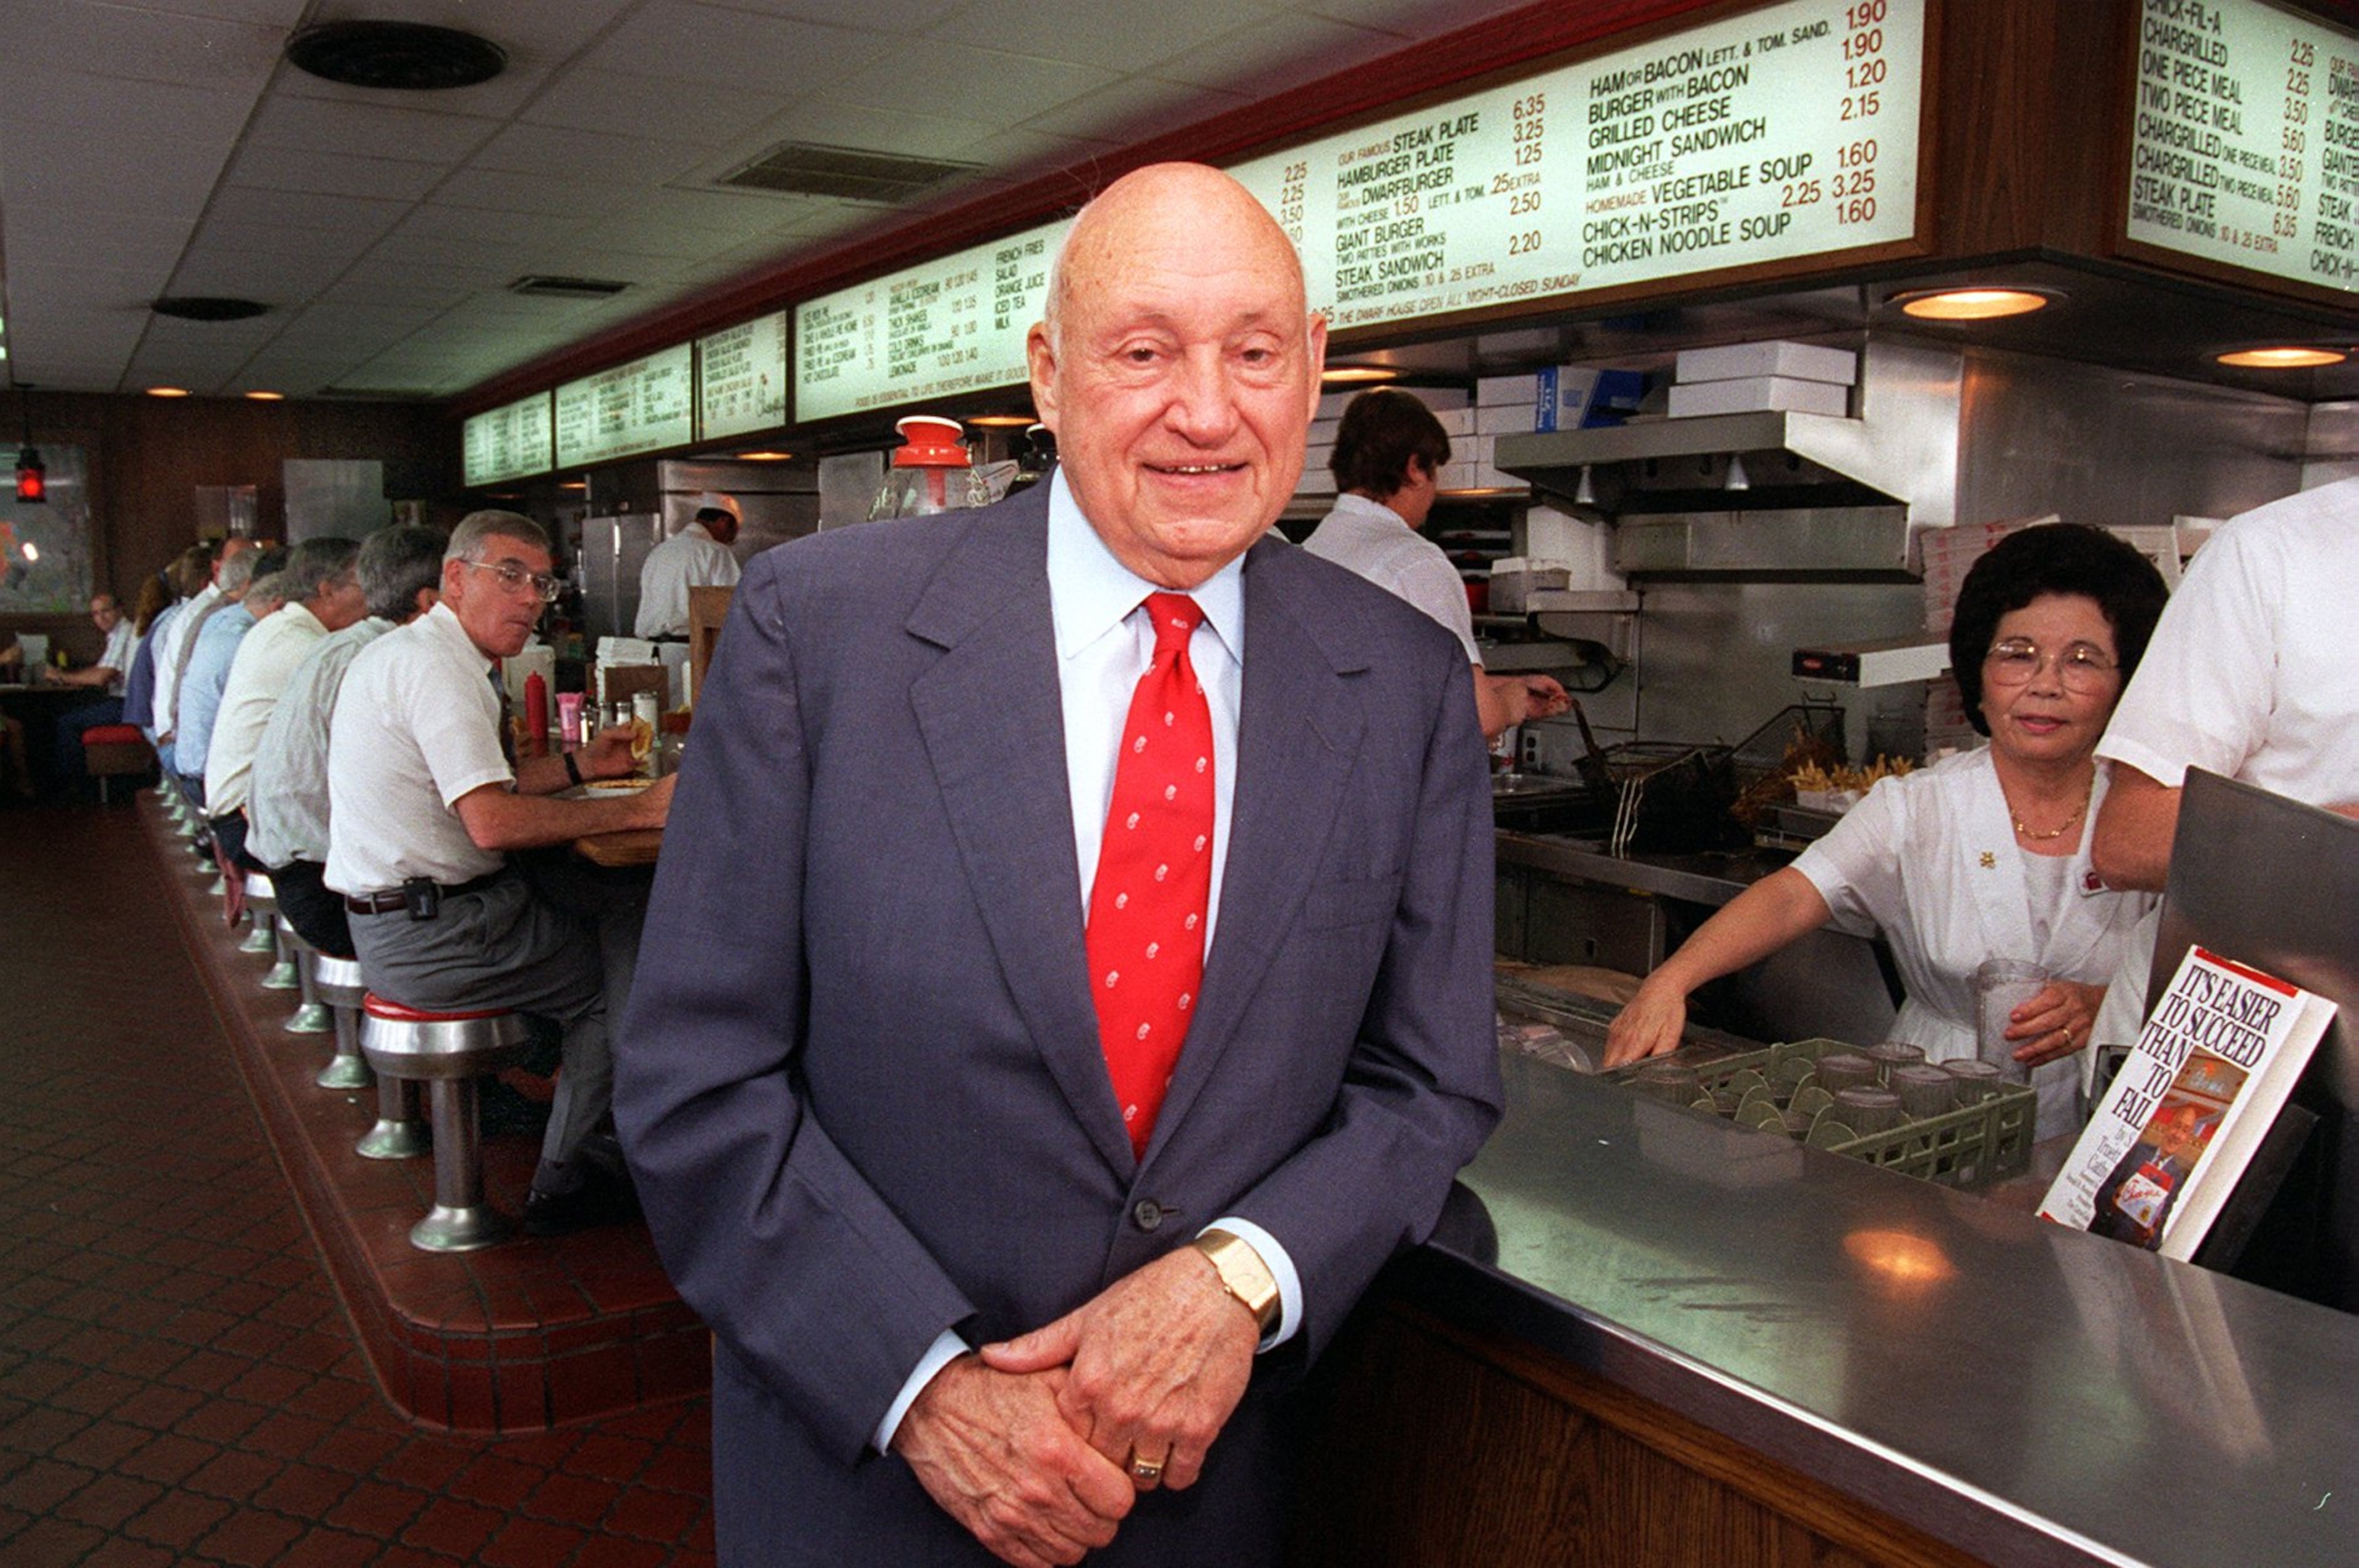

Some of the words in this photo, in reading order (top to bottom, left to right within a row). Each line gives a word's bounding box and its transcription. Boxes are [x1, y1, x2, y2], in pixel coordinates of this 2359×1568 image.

[1588, 89, 1654, 124] BURGER
[1656, 84, 1685, 103] WITH
[1687, 63, 1750, 99] BACON
[1843, 29, 1883, 60] 1.90
[1590, 71, 1625, 98] HAM
[1627, 69, 1643, 87] OR
[1644, 48, 1703, 84] BACON
[1705, 45, 1739, 68] LETT.
[1743, 41, 1751, 57] &
[1757, 33, 1786, 53] TOM.
[1791, 20, 1832, 44] SAND.
[1846, 0, 1886, 29] 1.90
[2144, 16, 2228, 68] CHARGRILLED
[2286, 67, 2310, 96] 2.25
[2290, 38, 2315, 68] 2.25
[1588, 115, 1654, 149] GRILLED
[1662, 96, 1732, 131] CHEESE
[1845, 59, 1886, 89] 1.20
[2141, 80, 2170, 112] TWO
[2174, 92, 2209, 125] PIECE
[2213, 104, 2243, 135] MEAL
[2282, 126, 2306, 154] 5.60
[2142, 48, 2170, 80] ONE
[2173, 58, 2208, 93] PIECE
[2211, 72, 2243, 105] MEAL
[2283, 96, 2309, 126] 3.50
[1337, 155, 1411, 189] HAMBURGER
[1416, 142, 1455, 168] PLATE
[1513, 118, 1544, 143] 3.25
[1393, 125, 1434, 153] STEAK
[1439, 112, 1480, 141] PLATE
[1513, 93, 1546, 120] 6.35
[1587, 140, 1664, 176] MIDNIGHT
[1671, 116, 1766, 157] SANDWICH
[1841, 91, 1880, 120] 2.15
[2138, 112, 2222, 159] CHARGRILLED
[2223, 145, 2237, 165] ONE
[2279, 155, 2303, 184] 3.50
[1337, 216, 1355, 230] WITH
[1358, 207, 1390, 226] CHEESE
[1394, 195, 1420, 217] 1.50
[1454, 191, 1461, 203] &
[1509, 171, 1541, 191] EXTRA
[1362, 166, 1453, 205] DWARFBURGER
[1515, 141, 1543, 166] 1.25
[1586, 175, 1610, 192] HAM
[1615, 173, 1622, 186] &
[1629, 160, 1675, 184] CHEESE
[1586, 189, 1647, 214] HOMEMADE
[1652, 165, 1750, 204] VEGETABLE
[1759, 153, 1813, 184] SOUP
[1837, 139, 1877, 168] 1.60
[1782, 179, 1821, 208] 2.25
[1832, 170, 1875, 198] 3.25
[2136, 144, 2220, 189] CHARGRILLED
[2276, 184, 2301, 211] 5.60
[1336, 227, 1370, 252] GIANT
[1374, 217, 1425, 243] BURGER
[1509, 190, 1541, 216] 2.50
[1583, 236, 1653, 268] CHICKEN
[1660, 222, 1731, 254] NOODLE
[1740, 212, 1791, 241] SOUP
[1836, 197, 1876, 225] 1.60
[2134, 174, 2175, 208] STEAK
[2180, 186, 2216, 219] PLATE
[2273, 212, 2298, 238] 6.35
[2314, 221, 2354, 251] FRENCH
[2318, 193, 2351, 222] STEAK
[1336, 252, 1354, 266] TWO
[1356, 247, 1387, 260] PATTIES
[1391, 240, 1411, 254] WITH
[1415, 232, 1447, 249] WORKS
[1336, 264, 1372, 288] STEAK
[1378, 250, 1444, 280] SANDWICH
[1509, 230, 1542, 255] 2.20
[1336, 282, 1385, 303] SMOTHERED
[1387, 276, 1419, 294] ONIONS
[1386, 299, 1418, 317] HOUSE
[1541, 272, 1582, 292] SUNDAY
[2159, 993, 2190, 1028] TO
[2182, 1006, 2266, 1068] SUCCEED
[2210, 978, 2281, 1035] EASIER
[2138, 1021, 2194, 1070] THAN
[2112, 1086, 2153, 1131] FAIL
[2143, 1062, 2173, 1099] TO
